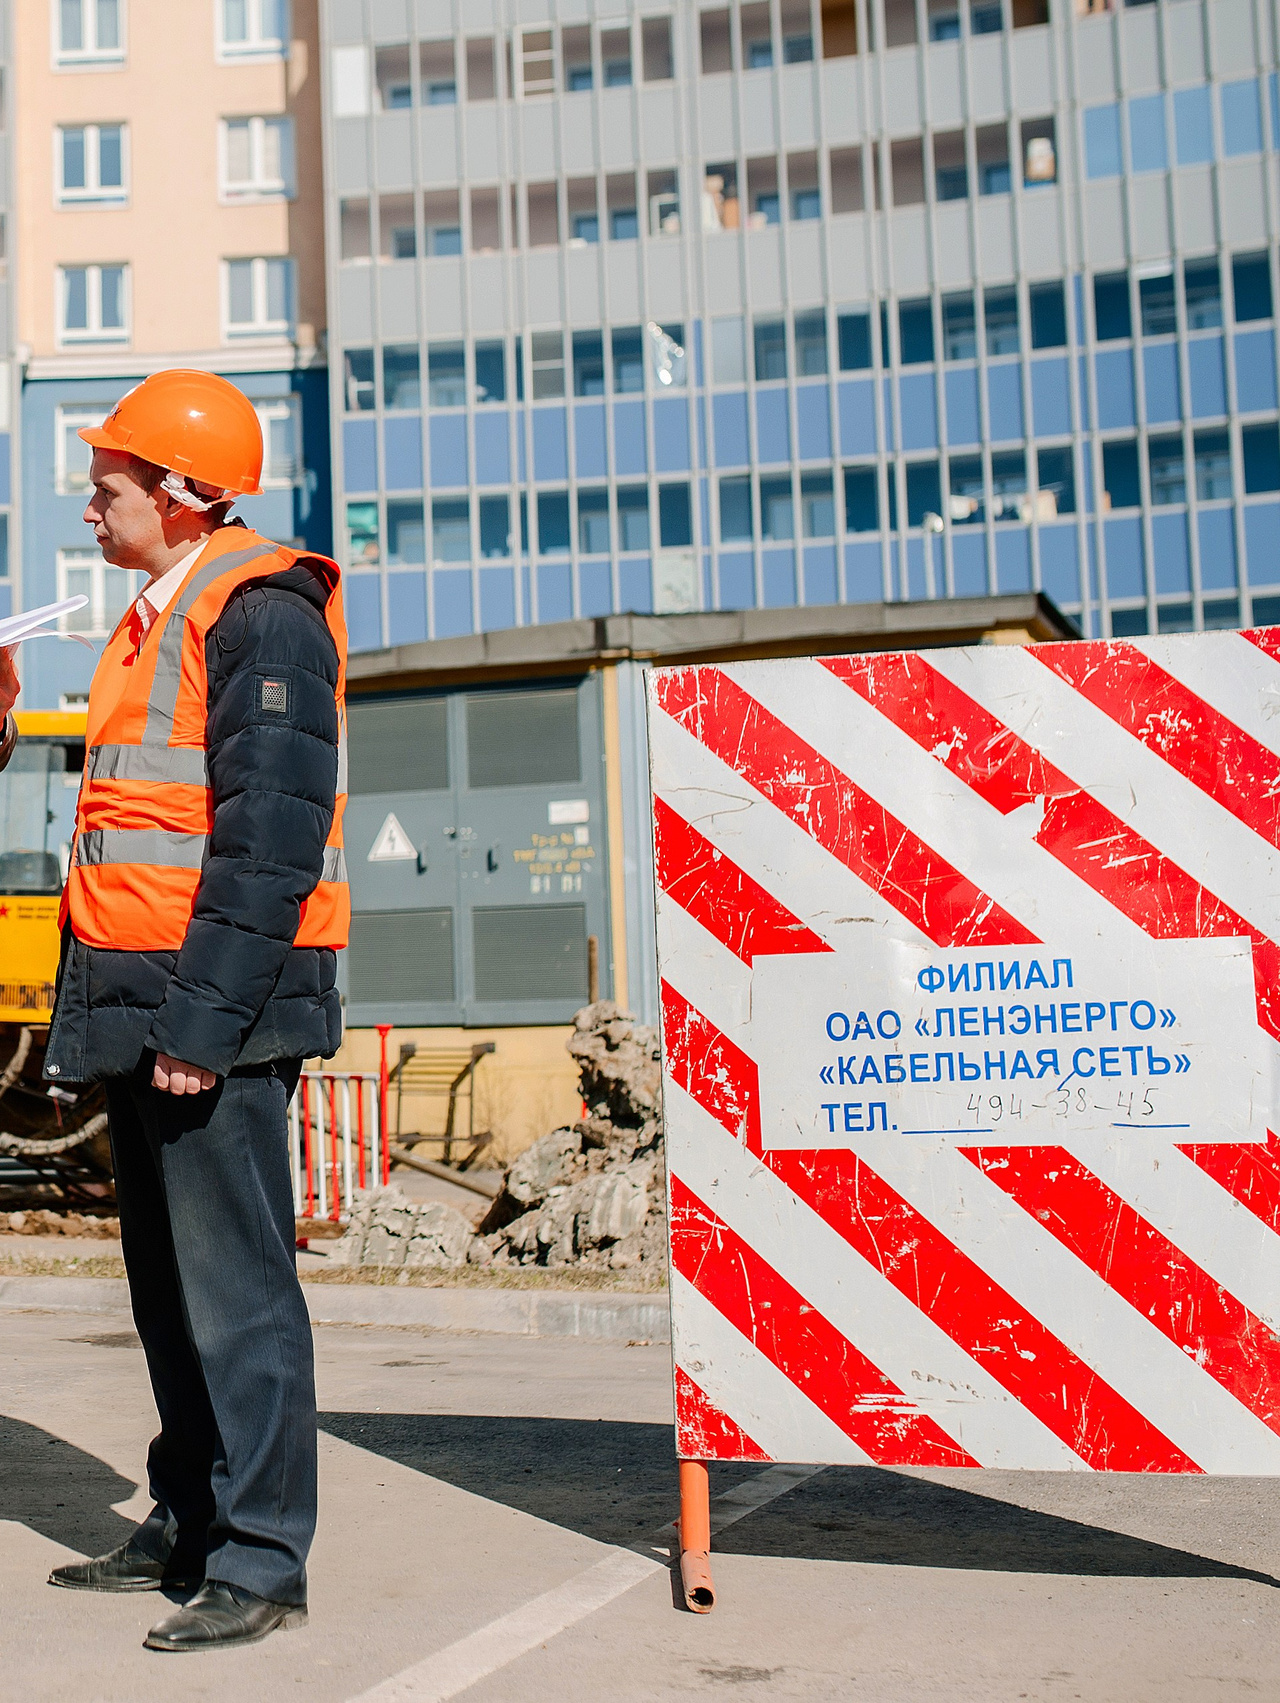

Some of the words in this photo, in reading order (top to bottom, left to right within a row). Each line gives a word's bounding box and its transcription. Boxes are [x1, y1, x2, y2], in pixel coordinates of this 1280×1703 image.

[917, 958, 1074, 993] ФИЛИАЛ
[825, 1009, 901, 1042] ОАО
[914, 1000, 1177, 1038] «ЛЕНЭНЕРГО»
[819, 1048, 1061, 1085] «КАБЕЛЬНАЯ
[1072, 1045, 1191, 1078] СЕТЬ»
[821, 1101, 898, 1133] ТЕЛ.
